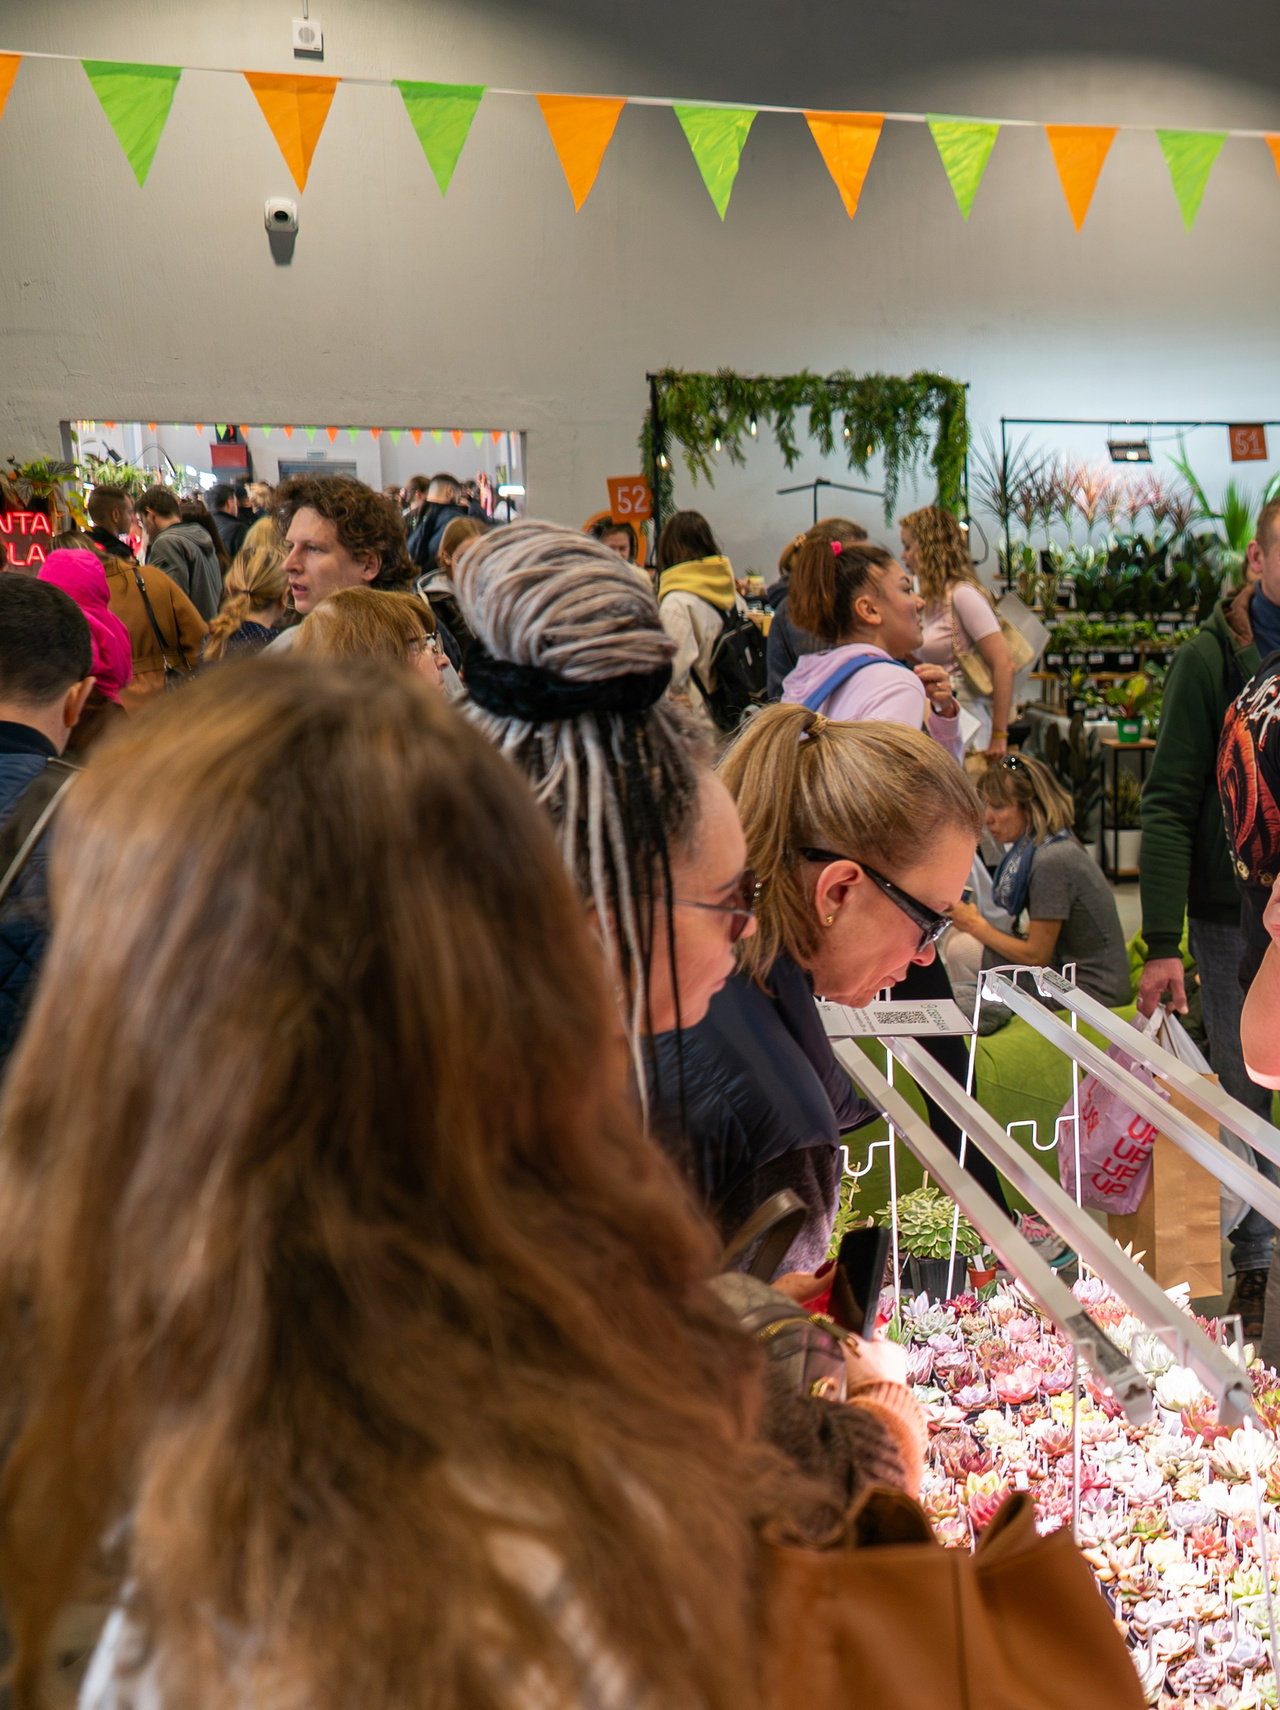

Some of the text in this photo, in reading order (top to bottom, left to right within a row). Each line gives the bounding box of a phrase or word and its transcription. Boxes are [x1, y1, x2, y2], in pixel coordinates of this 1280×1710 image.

[1235, 429, 1263, 455] 51
[617, 484, 648, 514] 52
[1113, 1137, 1150, 1164] UP
[1102, 1157, 1139, 1181] UP
[1091, 1172, 1127, 1195] UP
